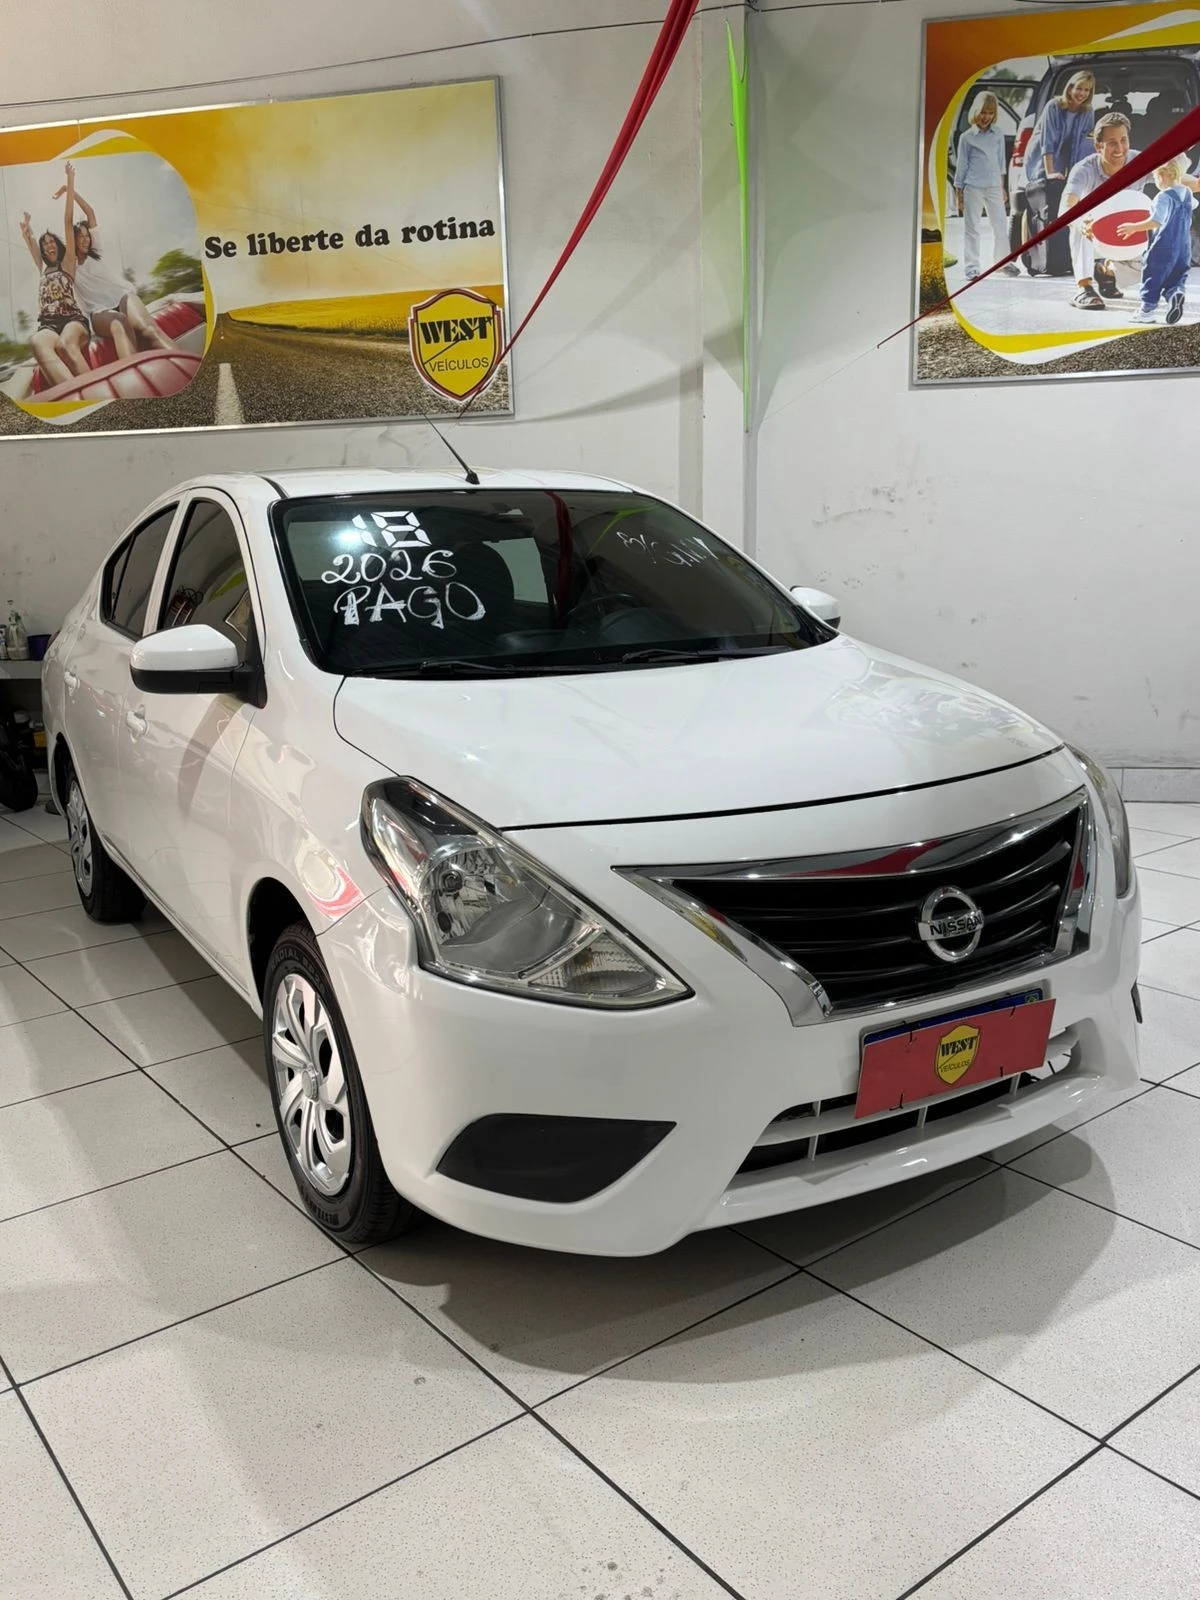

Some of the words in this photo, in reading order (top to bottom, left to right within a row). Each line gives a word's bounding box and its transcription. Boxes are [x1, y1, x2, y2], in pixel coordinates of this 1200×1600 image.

[204, 235, 237, 259] Se
[246, 229, 344, 256] liberte
[354, 224, 390, 247] da
[401, 216, 495, 244] rotina
[419, 315, 493, 344] WEST
[428, 356, 490, 373] VEÍCULOS
[351, 510, 433, 548] 18
[321, 549, 458, 584] 2026
[333, 582, 486, 629] PAGO
[930, 914, 982, 935] NISSAN
[941, 1036, 977, 1056] WEST
